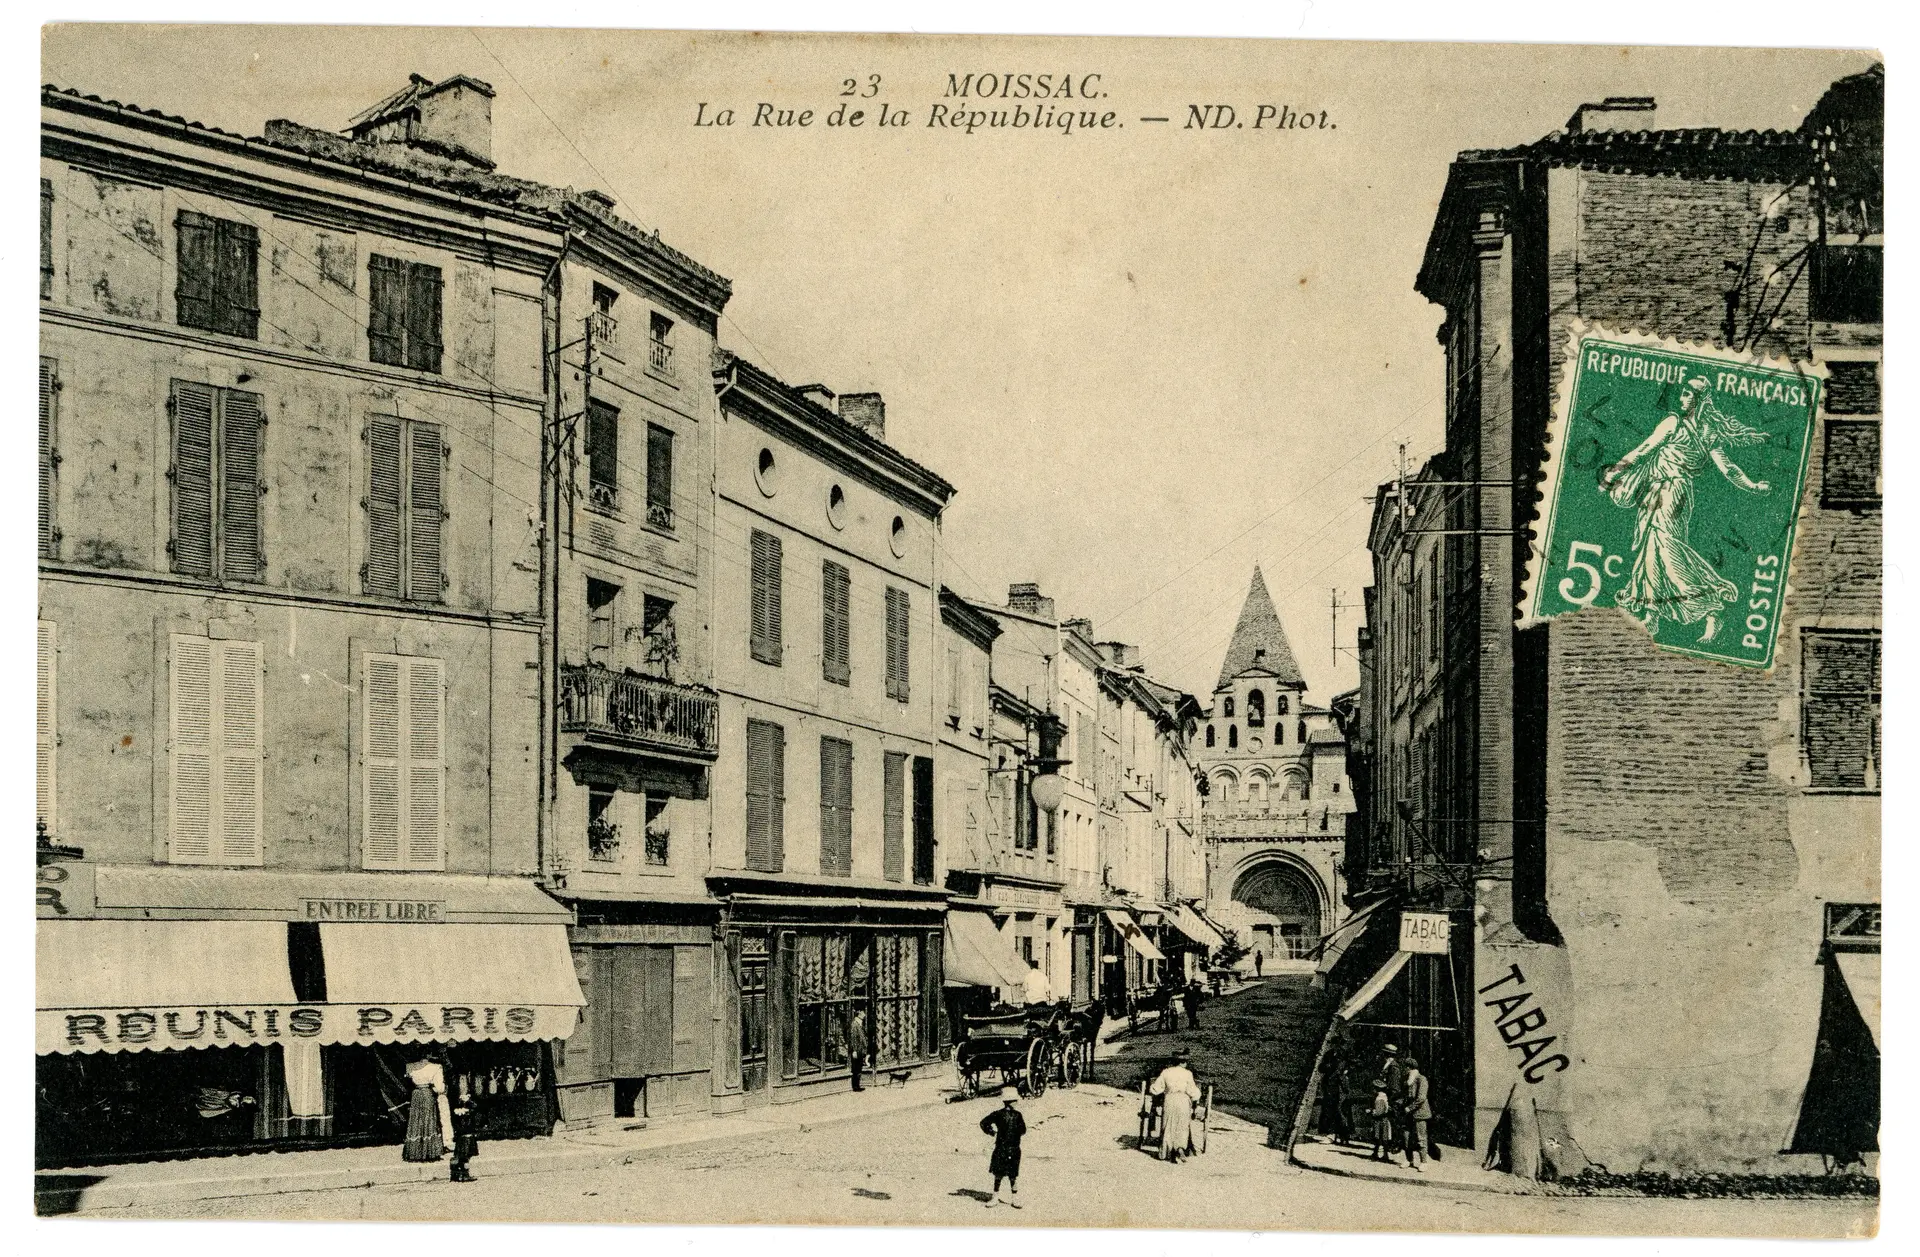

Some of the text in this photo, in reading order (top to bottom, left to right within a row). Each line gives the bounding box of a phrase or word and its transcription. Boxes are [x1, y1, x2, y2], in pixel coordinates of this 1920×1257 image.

[1742, 554, 1779, 649] POSTES
[385, 903, 439, 920] LIBRE
[1404, 918, 1448, 939] TABAC
[356, 1006, 537, 1037] PARIS
[1478, 963, 1571, 1085] TABAC
